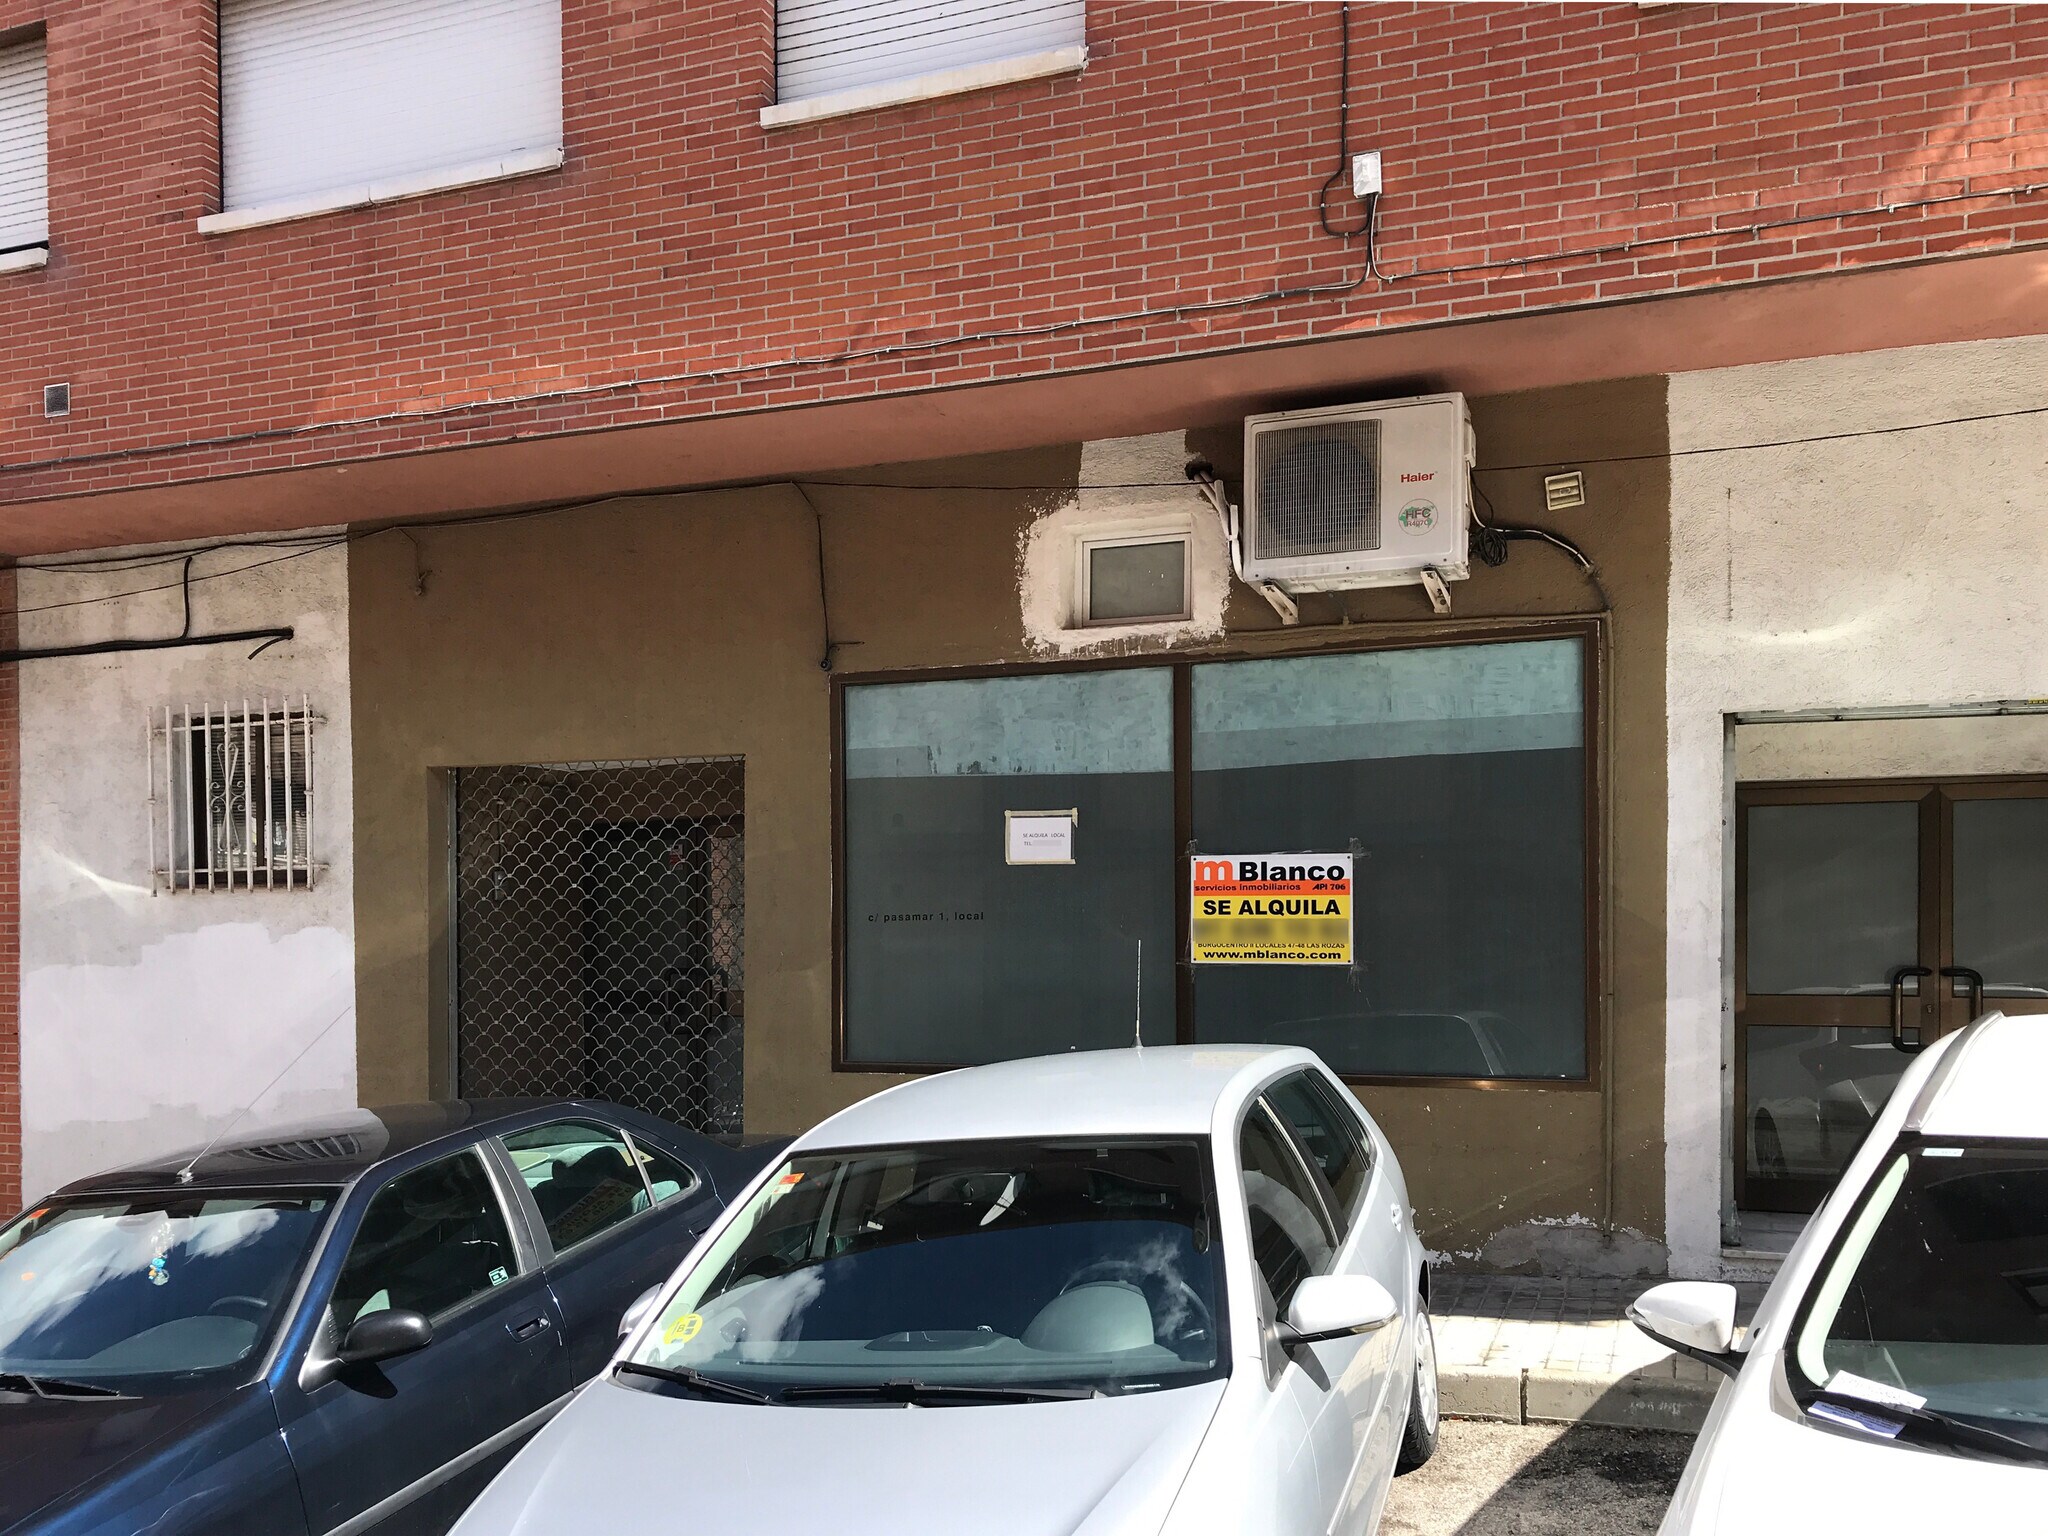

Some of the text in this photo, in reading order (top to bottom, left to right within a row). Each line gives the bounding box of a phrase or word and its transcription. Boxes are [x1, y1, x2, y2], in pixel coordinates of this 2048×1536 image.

[1400, 472, 1434, 483] Haier
[1405, 508, 1431, 519] HFC
[1239, 861, 1345, 881] Blanco
[1194, 883, 1346, 892] servicios inmobiliarios API 706
[1203, 899, 1341, 917] SE ALQUILA
[868, 911, 985, 923] c/ pasamar 1, local
[1203, 950, 1341, 959] www.mblanco.com
